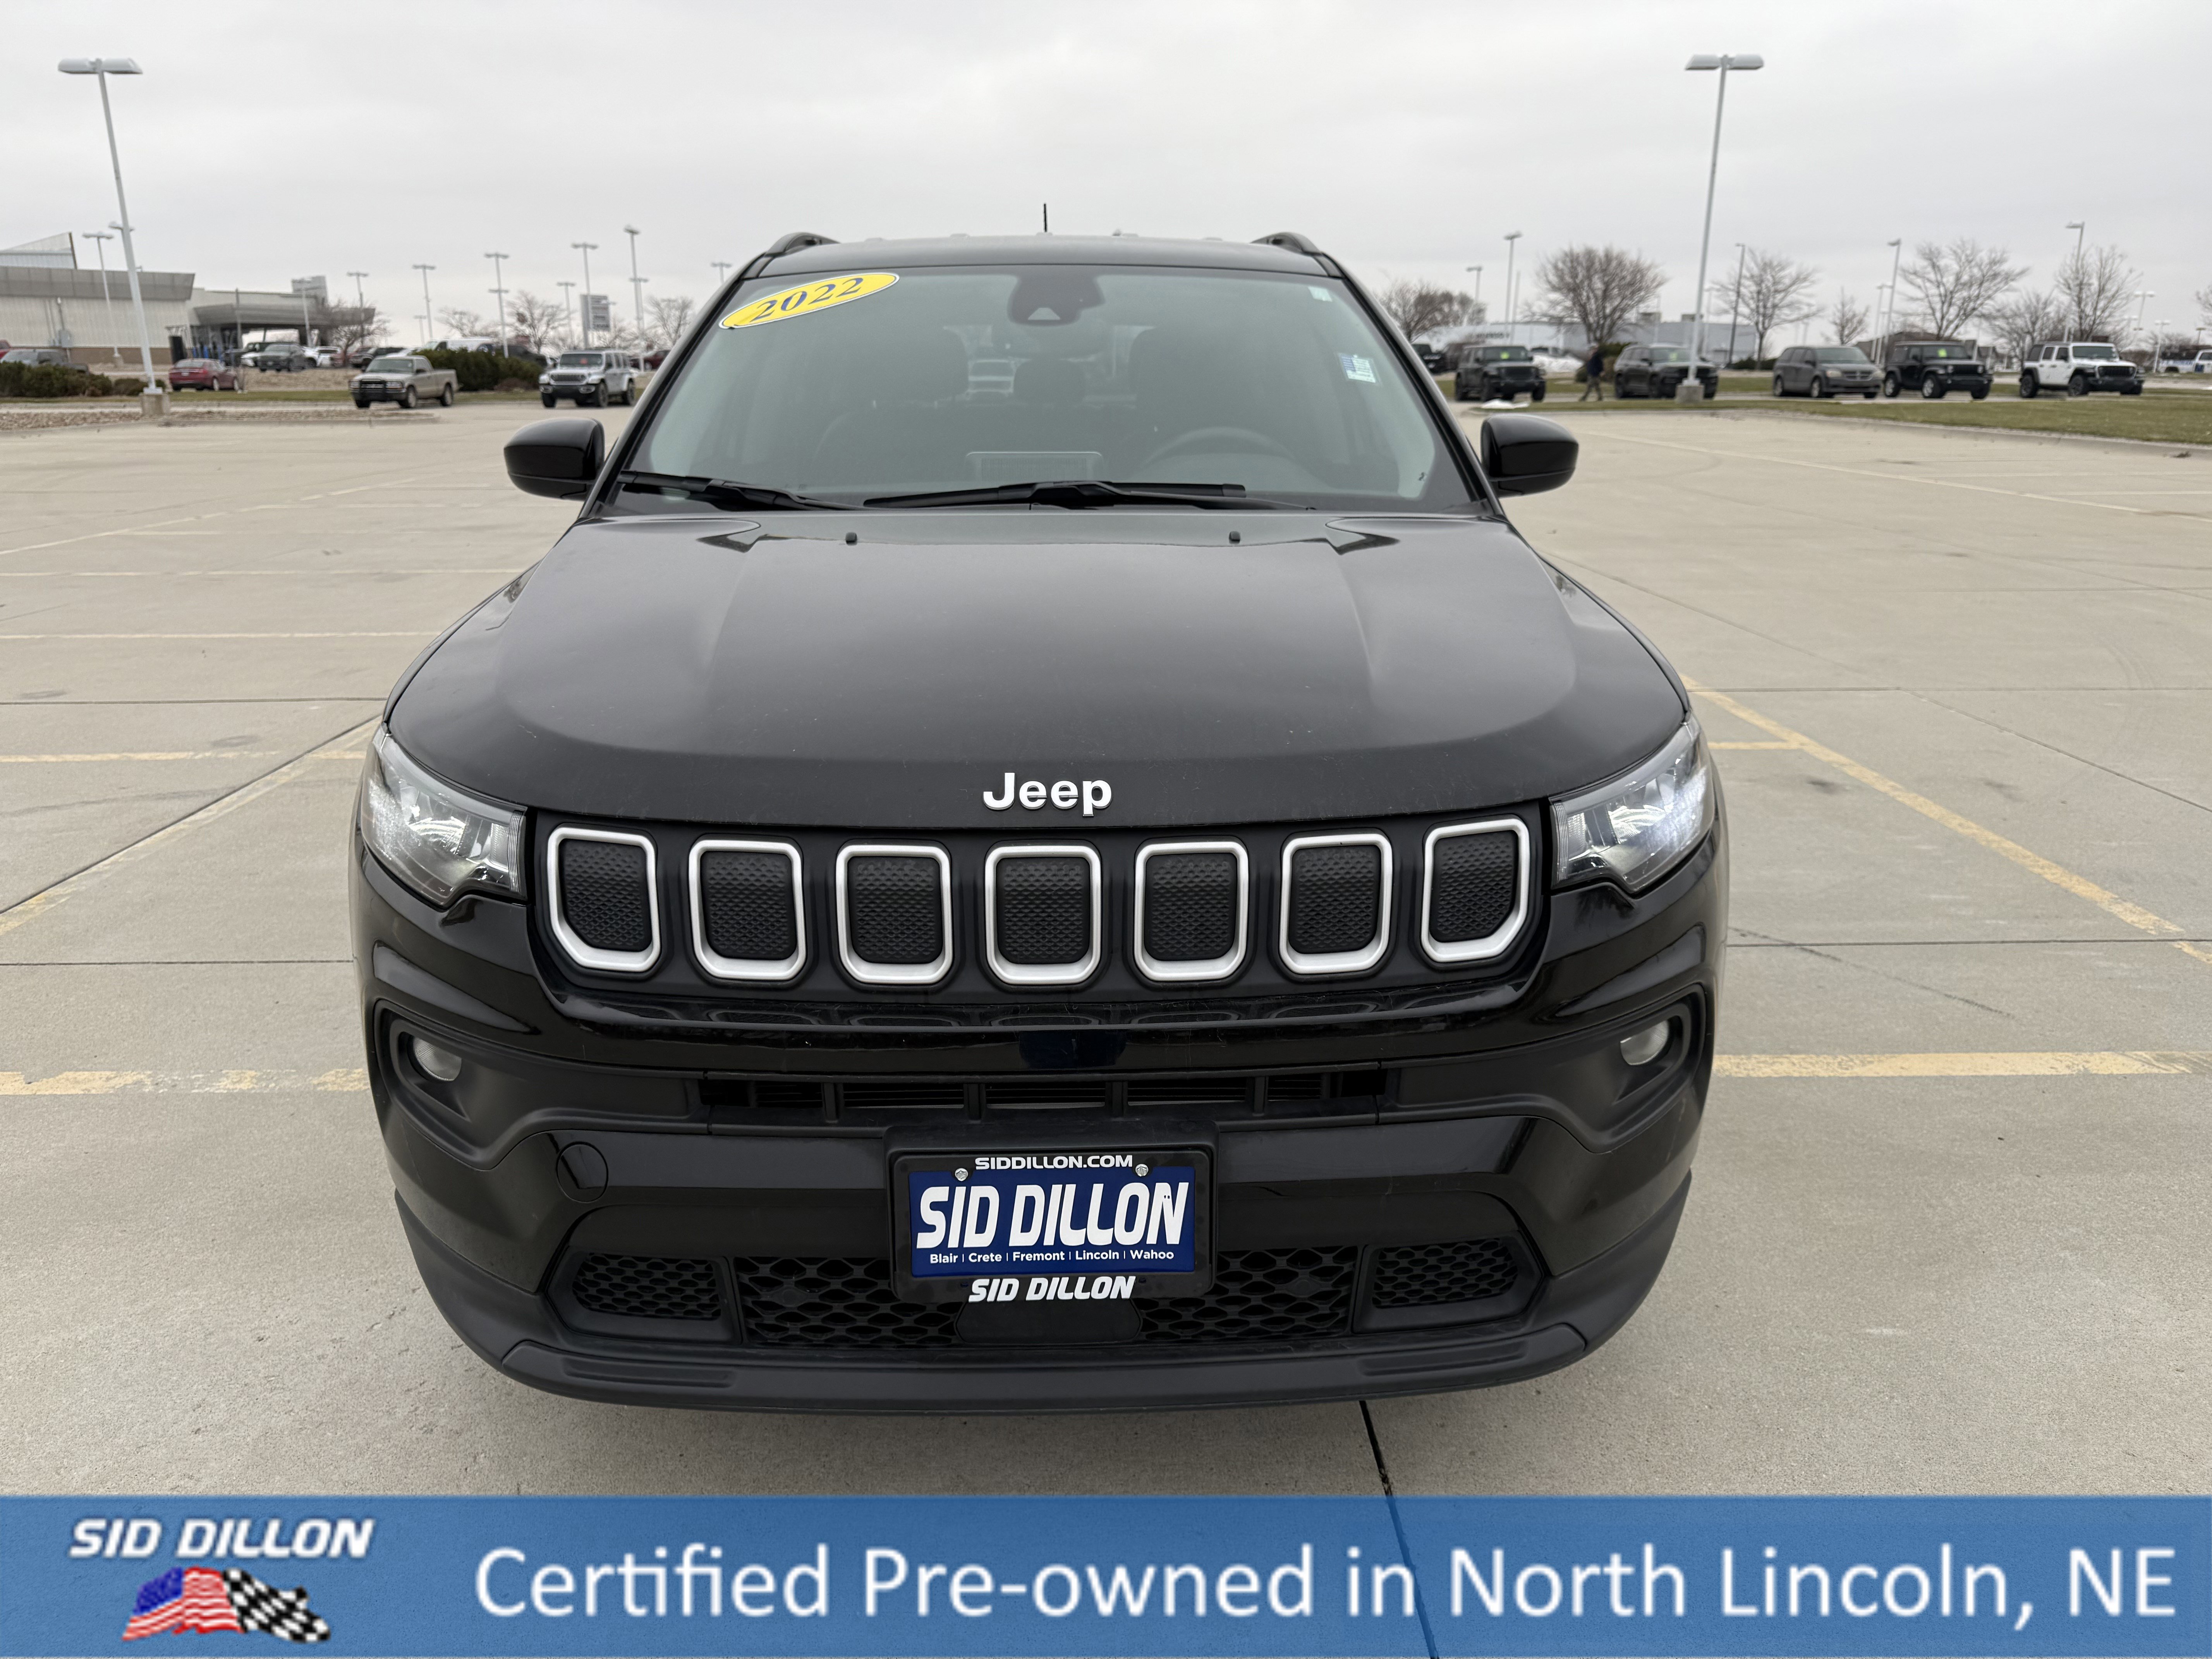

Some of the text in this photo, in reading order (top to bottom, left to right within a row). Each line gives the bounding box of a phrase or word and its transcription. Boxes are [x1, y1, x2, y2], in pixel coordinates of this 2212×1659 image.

[750, 278, 864, 322] 2022
[983, 772, 1112, 816] Jeep
[975, 1155, 1133, 1170] SIDDILLON.COM
[916, 1182, 1189, 1249] SID DILLON
[930, 1249, 1174, 1264] Blair Crete Fremont Lincoln Wahoo
[968, 1276, 1136, 1302] SID DILLON
